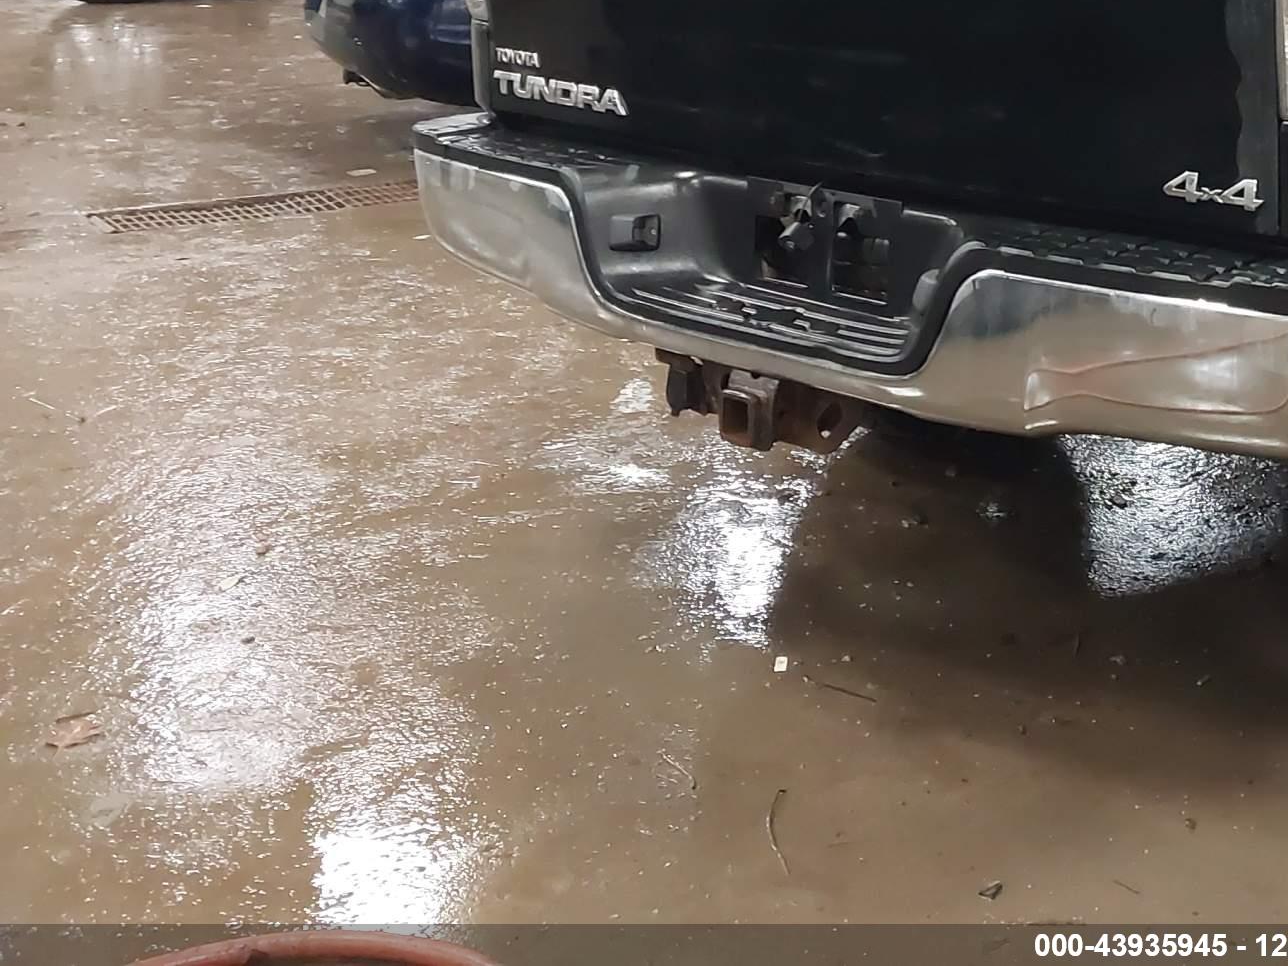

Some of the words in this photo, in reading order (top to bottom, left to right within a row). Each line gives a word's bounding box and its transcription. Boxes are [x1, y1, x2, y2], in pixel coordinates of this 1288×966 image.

[495, 46, 540, 68] TOYOTA
[493, 69, 630, 116] TUNDRA
[1162, 170, 1265, 212] 4x4
